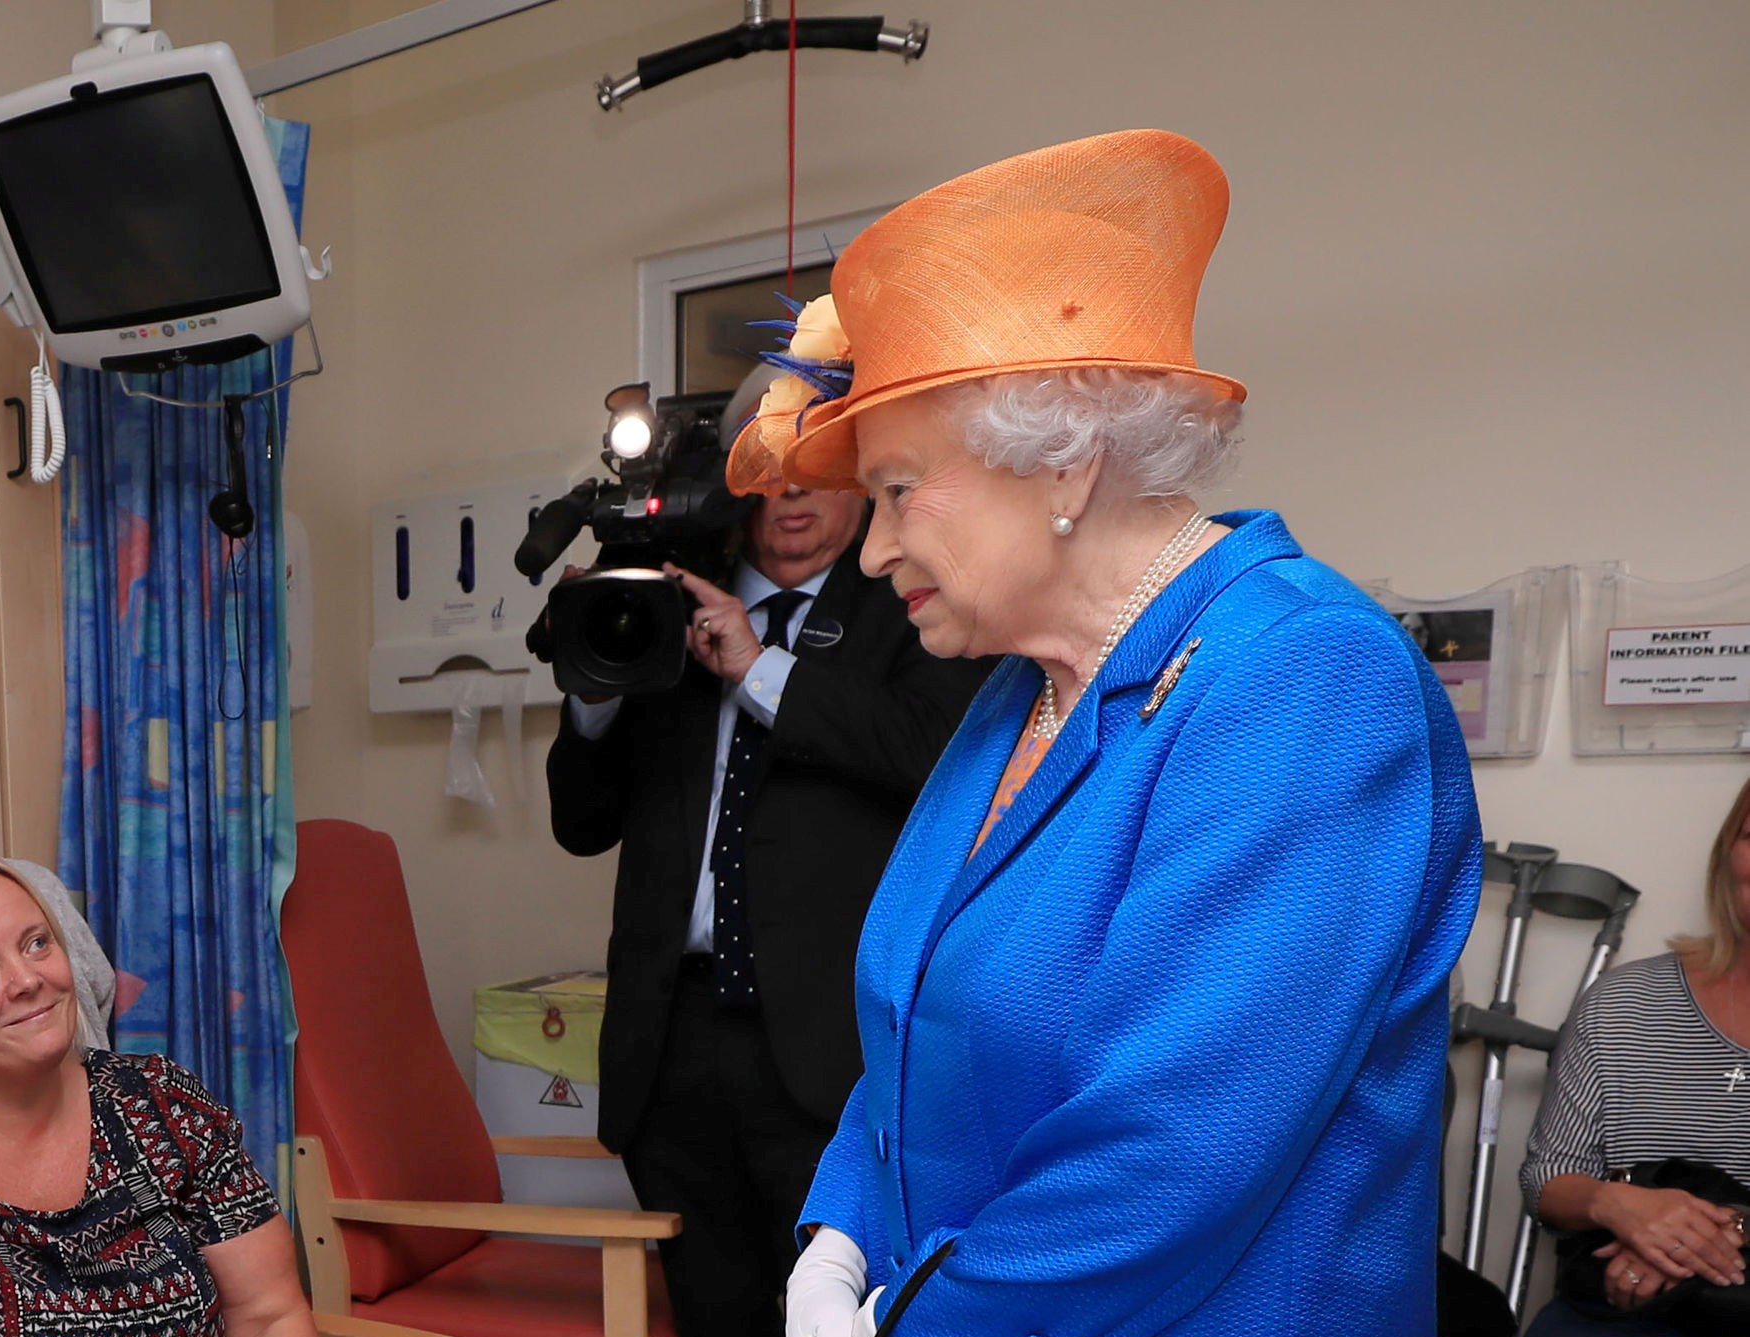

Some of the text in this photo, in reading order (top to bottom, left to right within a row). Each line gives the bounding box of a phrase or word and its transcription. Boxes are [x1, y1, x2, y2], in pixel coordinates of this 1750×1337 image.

[1652, 631, 1711, 641] PARENT
[1611, 645, 1750, 658] INFORMATION FILE
[1685, 687, 1704, 695] you
